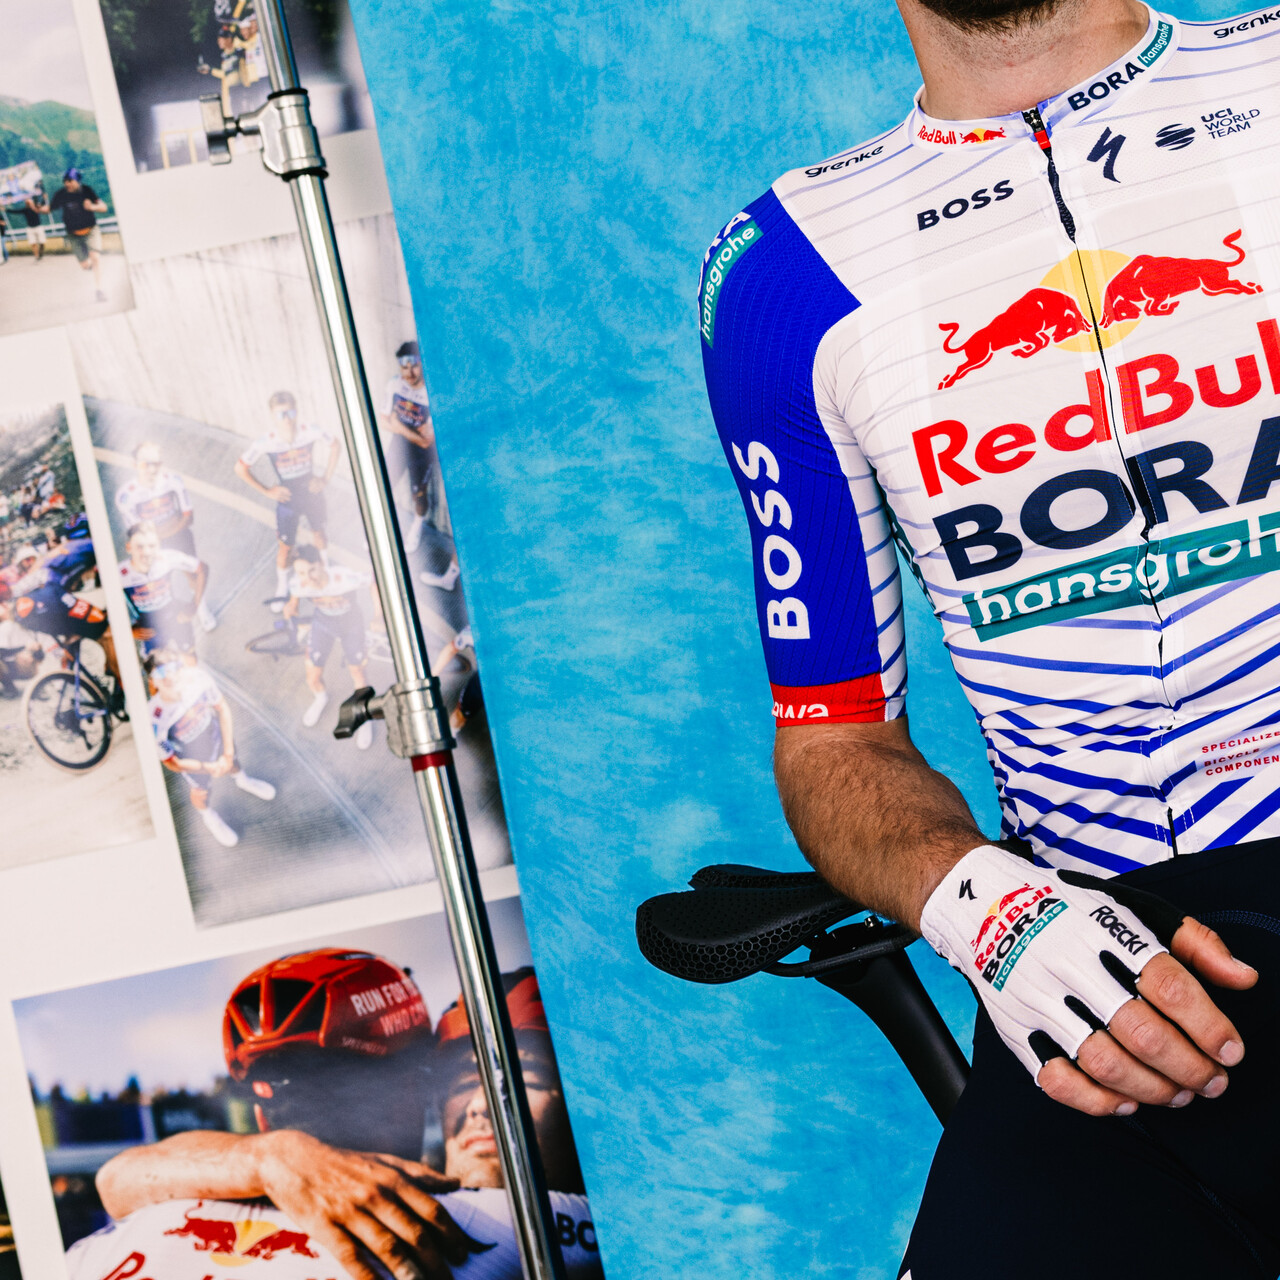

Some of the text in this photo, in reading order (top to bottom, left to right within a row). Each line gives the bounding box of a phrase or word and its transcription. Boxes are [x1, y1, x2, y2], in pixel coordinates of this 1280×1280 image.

[1141, 22, 1170, 65] hansgrohe
[1067, 61, 1145, 111] BORA
[917, 124, 957, 145] Red Bull
[1200, 107, 1233, 123] UCI
[1204, 108, 1261, 131] WORLD
[1207, 120, 1251, 140] TEAM
[804, 145, 884, 178] grenke
[916, 179, 1014, 232] BOSS
[701, 225, 757, 341] hansgrohe
[911, 366, 1113, 498] Red
[731, 439, 811, 641] BOSS
[1203, 747, 1260, 767] BICYCLE
[974, 885, 1053, 971] Red Bull
[982, 897, 1062, 984] BORA
[995, 903, 1067, 989] hansgrohe
[350, 988, 387, 1017] RUN
